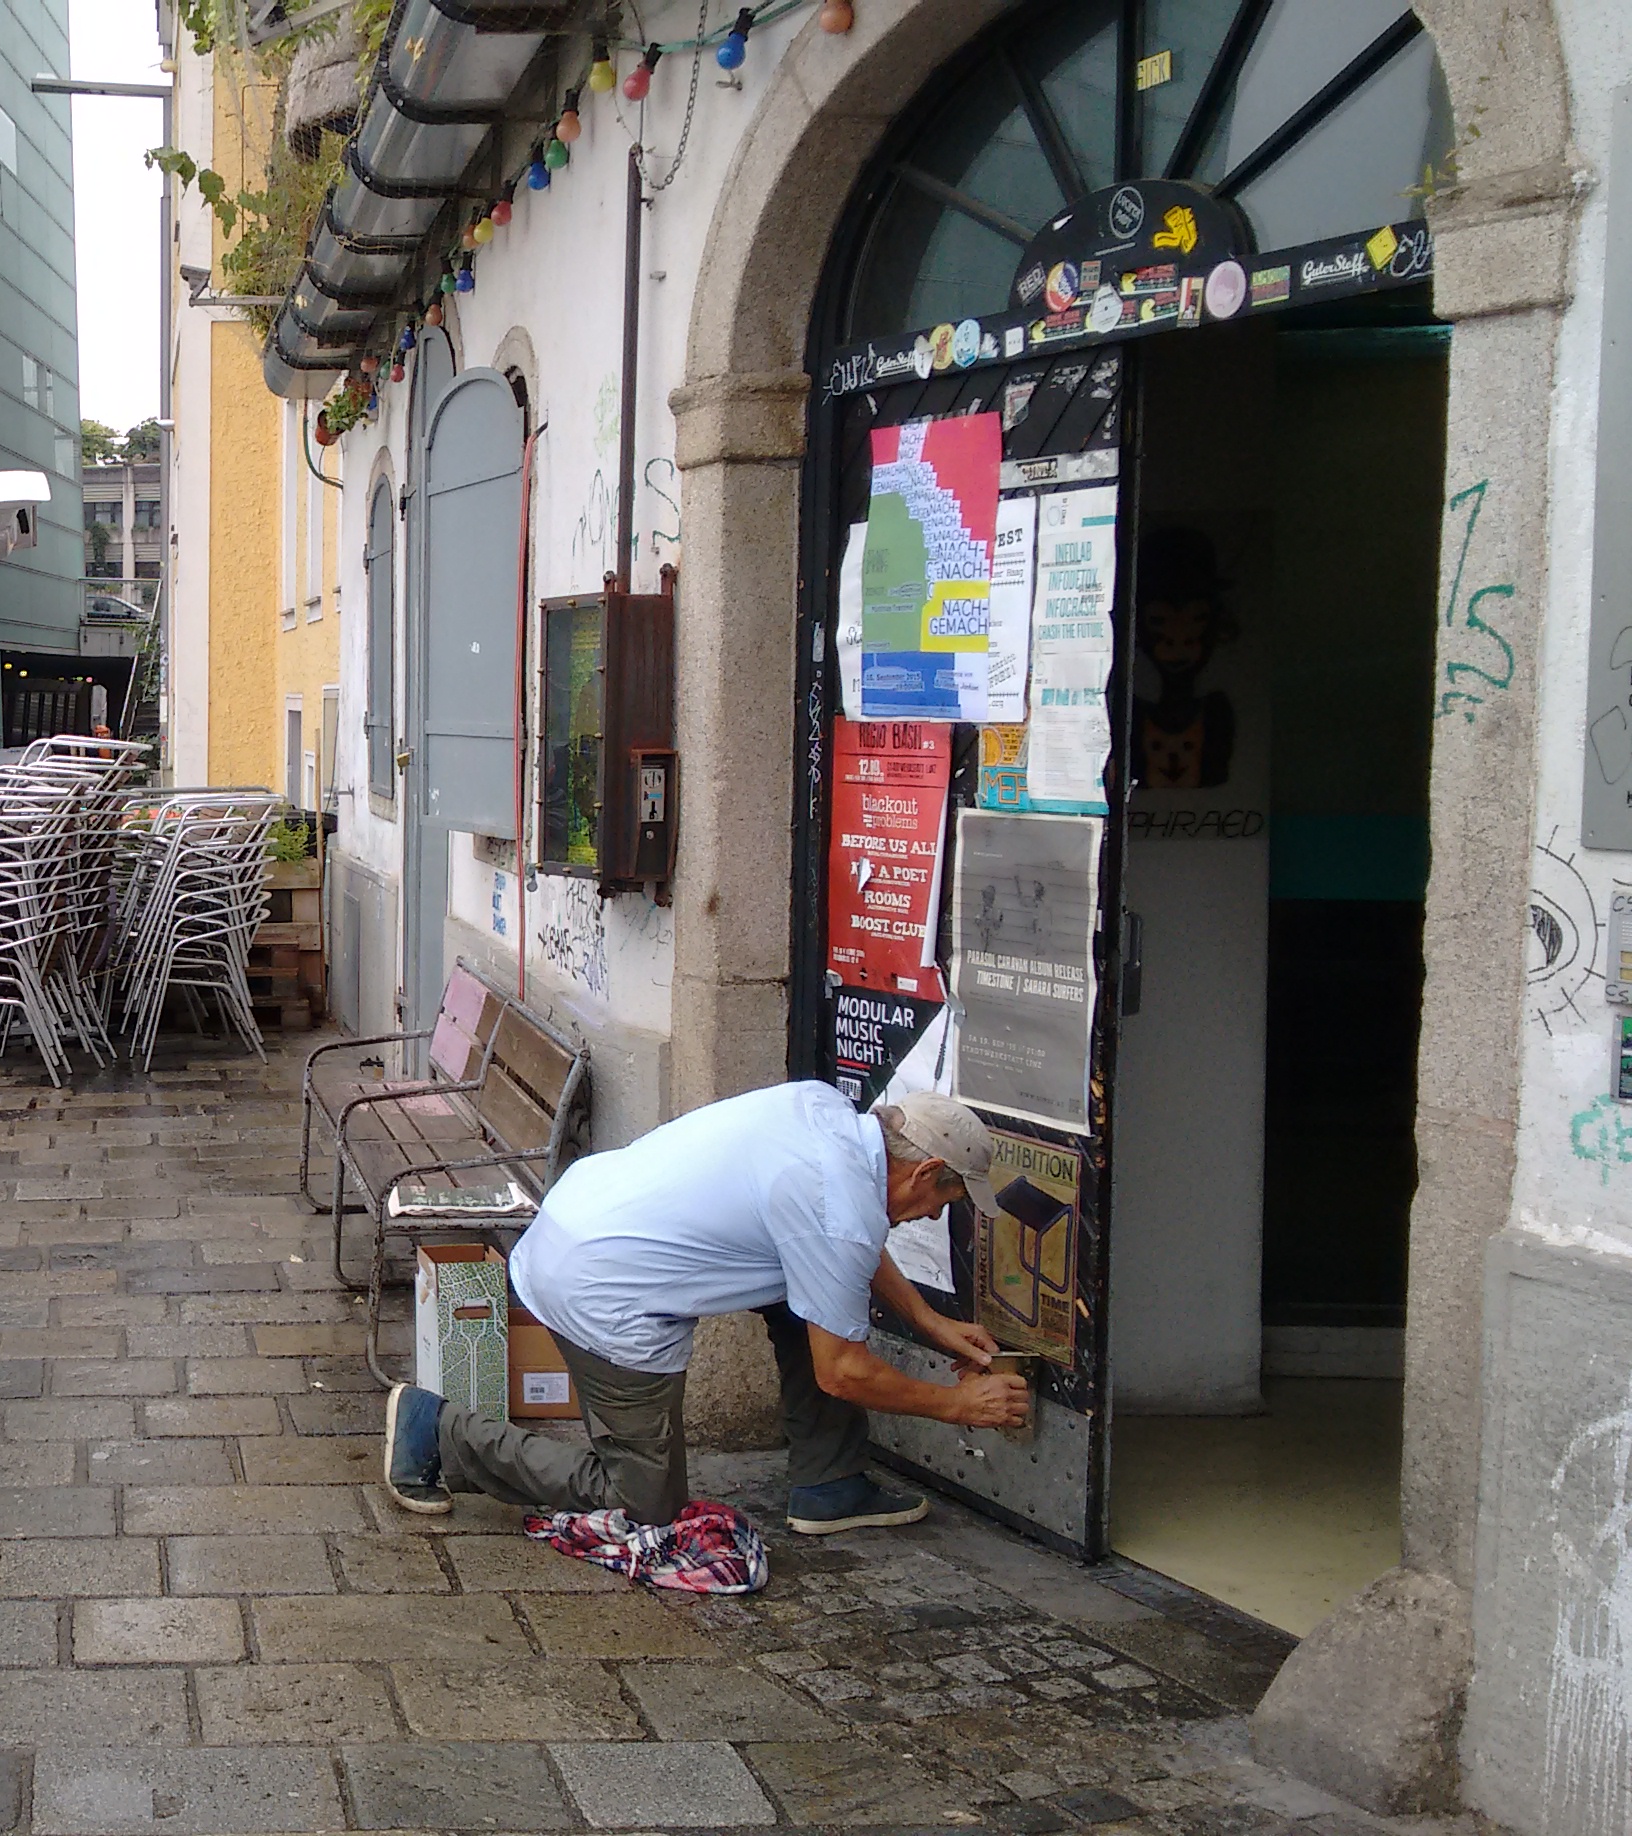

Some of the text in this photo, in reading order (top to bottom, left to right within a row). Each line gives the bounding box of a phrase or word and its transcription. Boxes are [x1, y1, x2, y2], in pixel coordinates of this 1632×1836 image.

[929, 617, 989, 636] GEMACH
[862, 793, 919, 816] blackout
[841, 834, 886, 851] BEFORE
[889, 840, 908, 853] US
[892, 866, 929, 883] POET
[864, 889, 912, 909] ROOMS
[1054, 963, 1086, 983] RELEASE
[837, 994, 915, 1029] MODULAR
[835, 1016, 884, 1045] MUSIC
[836, 1037, 885, 1066] NIGHT
